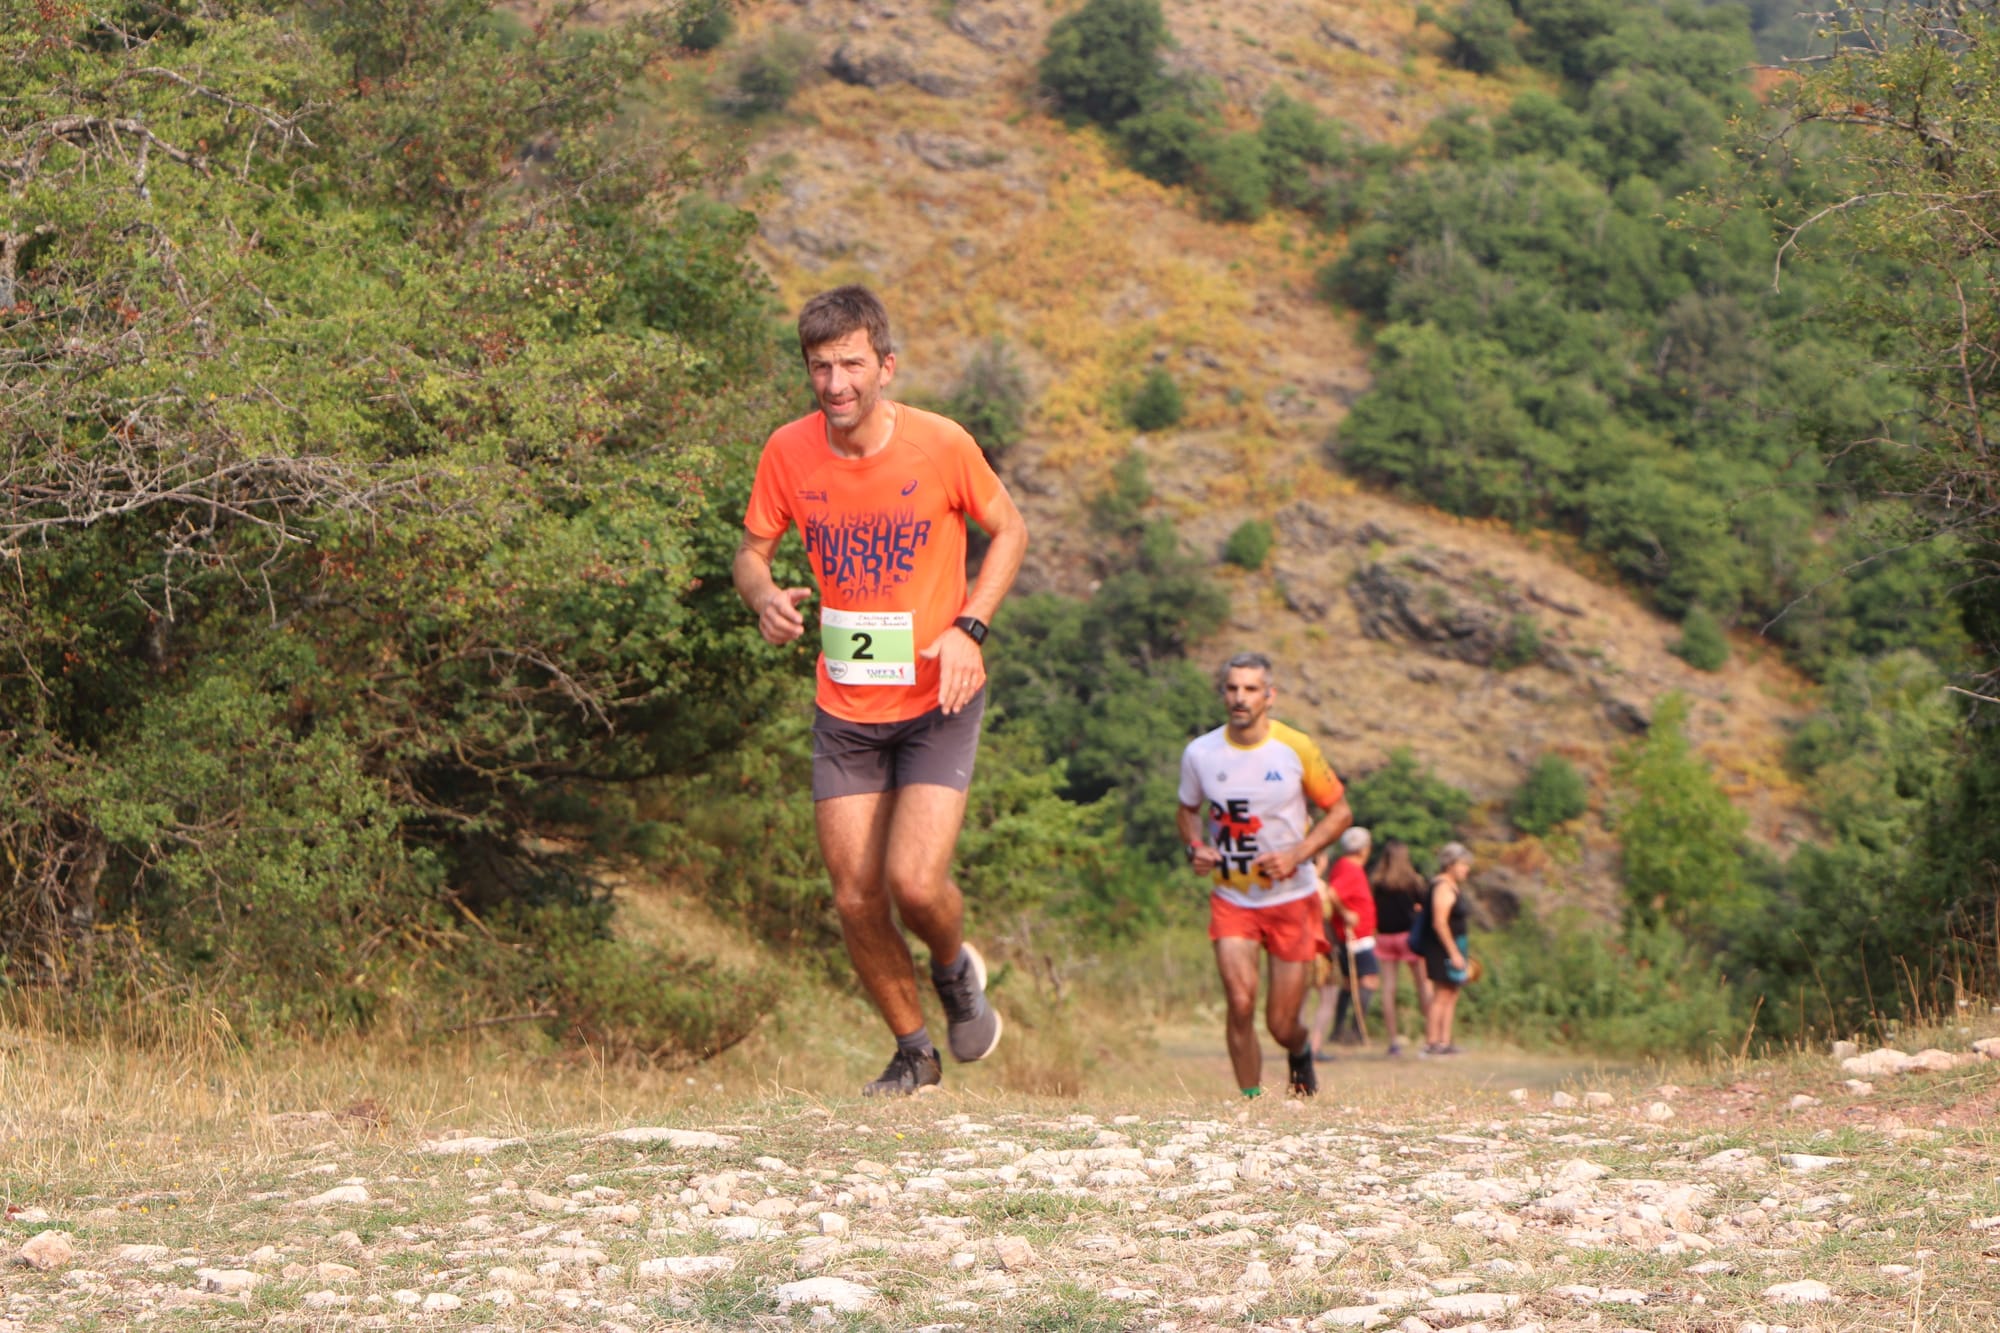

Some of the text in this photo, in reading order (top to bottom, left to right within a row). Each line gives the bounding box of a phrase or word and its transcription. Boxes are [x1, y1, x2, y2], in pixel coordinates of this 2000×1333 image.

[806, 520, 931, 557] FINISHER
[822, 548, 914, 587] PARIS
[851, 632, 873, 660] 2
